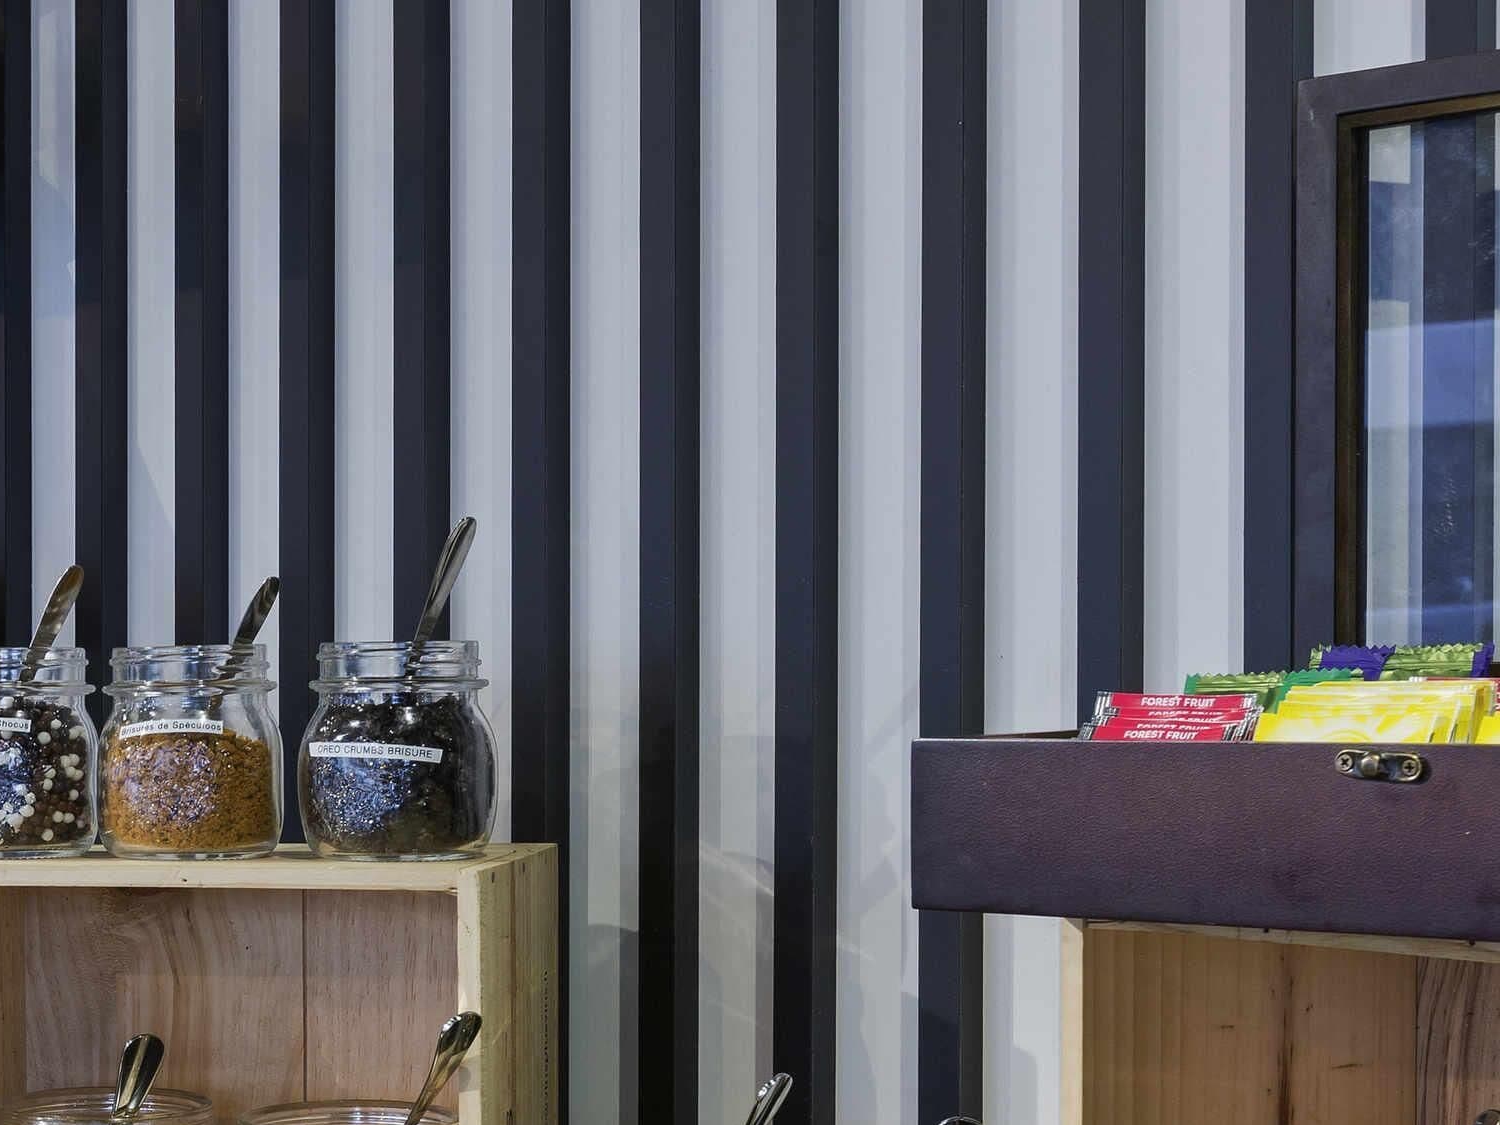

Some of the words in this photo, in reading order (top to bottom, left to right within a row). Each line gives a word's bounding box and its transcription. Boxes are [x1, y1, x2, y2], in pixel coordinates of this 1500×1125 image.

[1141, 696, 1181, 707] FOREST
[1183, 697, 1216, 707] FRUIT
[157, 722, 169, 730] de
[1123, 729, 1165, 739] FOREST
[1165, 731, 1199, 740] FRUIT
[317, 744, 341, 754] OREO
[343, 744, 384, 755] CRUMBS
[387, 745, 433, 759] BRISURE
